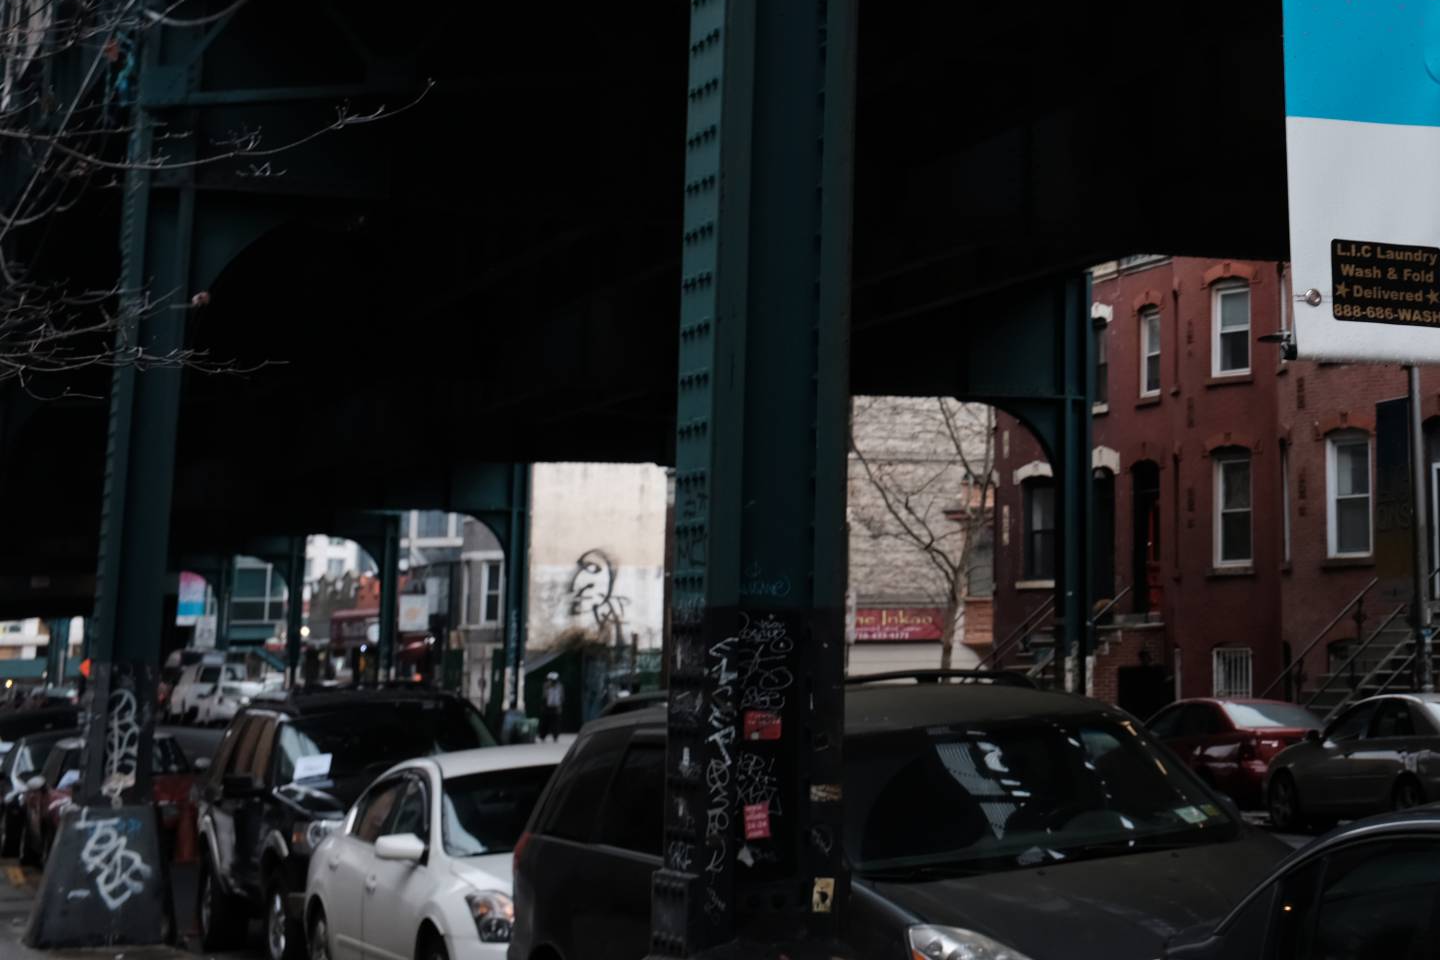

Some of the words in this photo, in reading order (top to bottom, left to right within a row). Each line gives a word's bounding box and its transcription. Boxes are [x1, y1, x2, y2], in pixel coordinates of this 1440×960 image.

[1376, 246, 1438, 266] Laundry
[1340, 263, 1381, 279] Wash
[1386, 266, 1398, 280] &
[1403, 268, 1434, 283] Fold
[1352, 284, 1424, 302] Delivered
